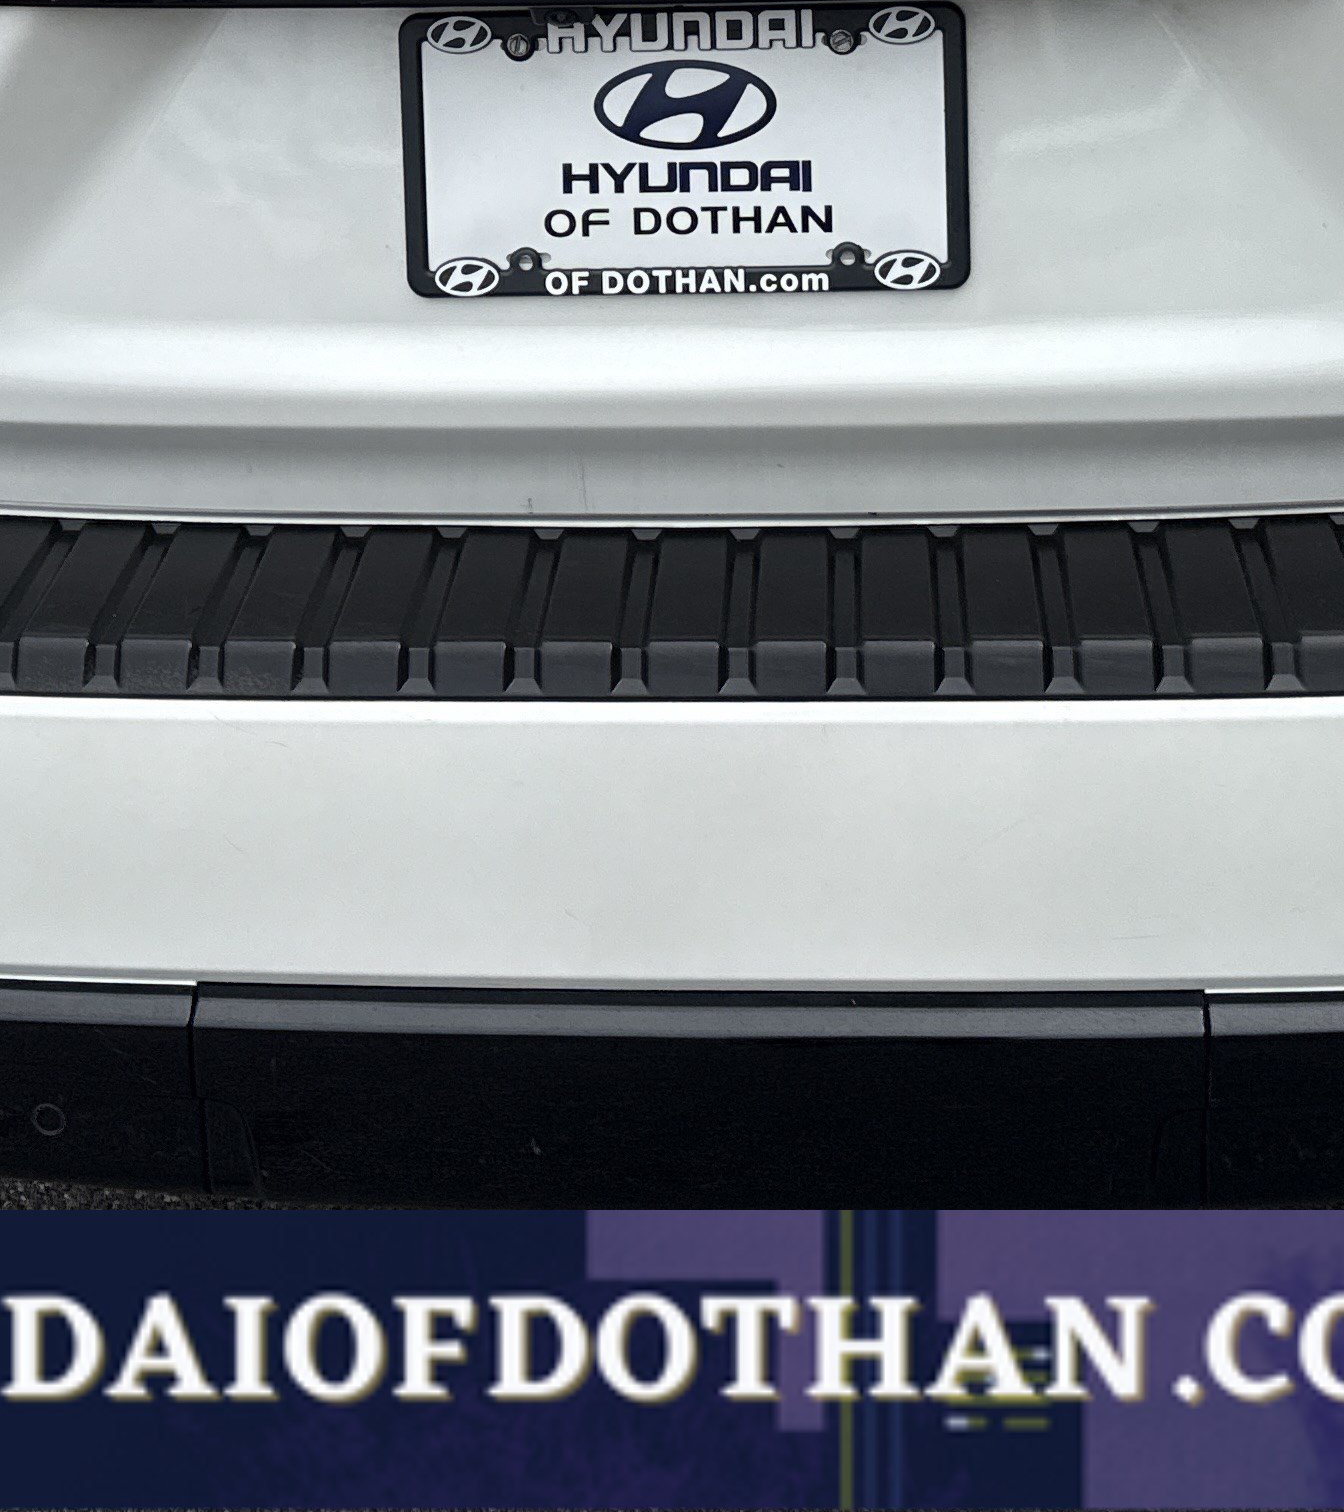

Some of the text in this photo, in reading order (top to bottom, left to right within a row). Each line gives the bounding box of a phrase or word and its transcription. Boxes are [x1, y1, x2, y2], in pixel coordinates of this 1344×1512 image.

[546, 9, 816, 53] HYUNDAI
[562, 160, 812, 194] HYUNDAI
[543, 204, 834, 238] OF DOTHAN
[544, 266, 830, 296] OF DOTHAN.com
